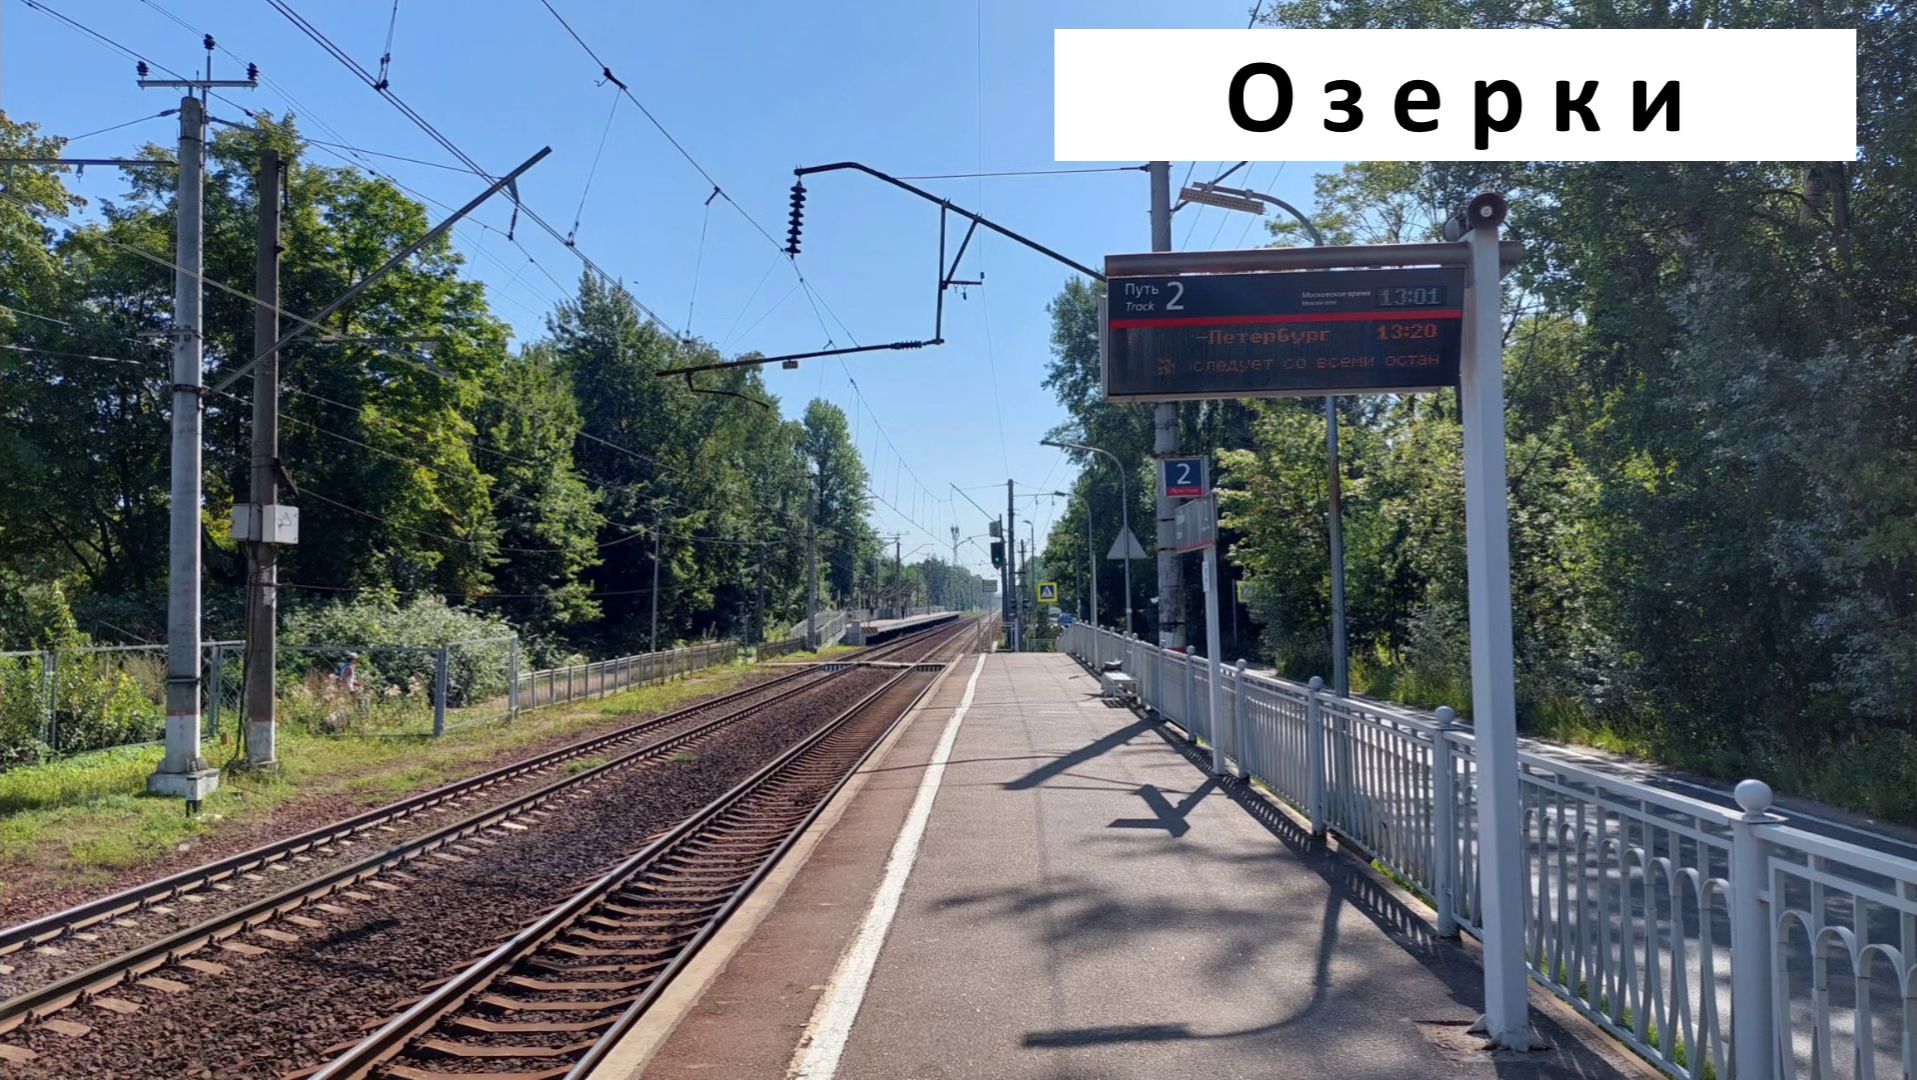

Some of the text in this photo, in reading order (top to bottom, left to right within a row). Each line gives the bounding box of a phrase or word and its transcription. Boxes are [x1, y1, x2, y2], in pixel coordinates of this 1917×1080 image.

[1125, 281, 1184, 310] Путь 2
[1379, 287, 1441, 306] 13:01
[1126, 301, 1155, 312] Track
[1377, 323, 1438, 340] 13:20
[1385, 354, 1440, 367] остан
[1176, 463, 1191, 485] 2
